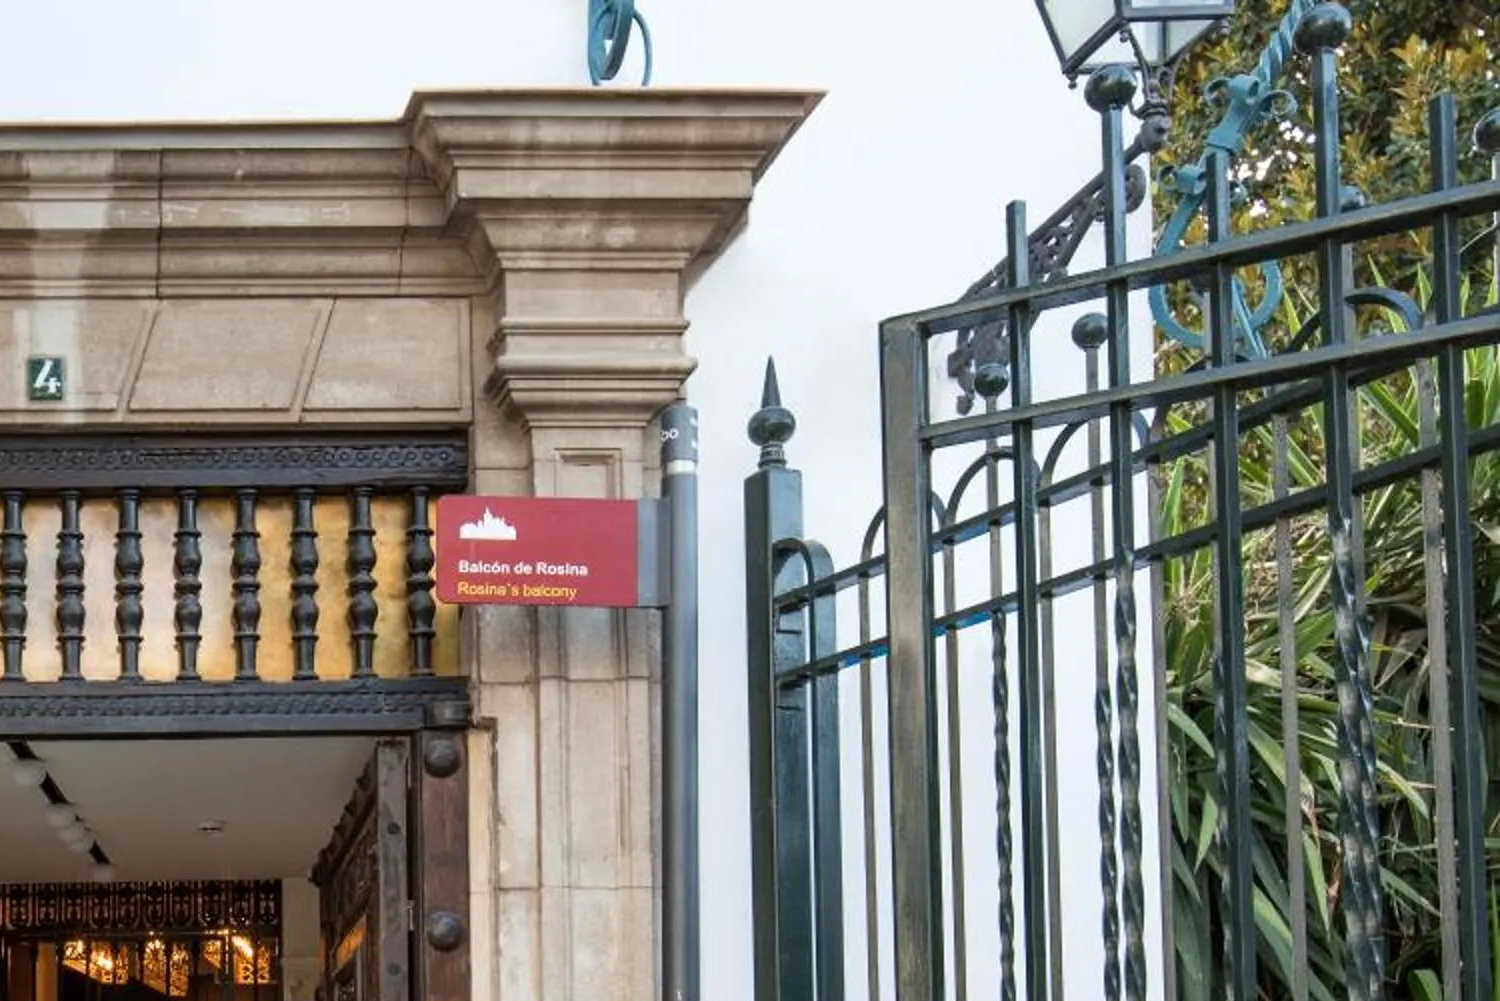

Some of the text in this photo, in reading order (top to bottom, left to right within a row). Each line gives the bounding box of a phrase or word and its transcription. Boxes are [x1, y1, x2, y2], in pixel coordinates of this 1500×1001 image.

[33, 360, 61, 393] 4
[458, 560, 588, 576] Balcón de Rosina
[523, 583, 577, 600] balcony
